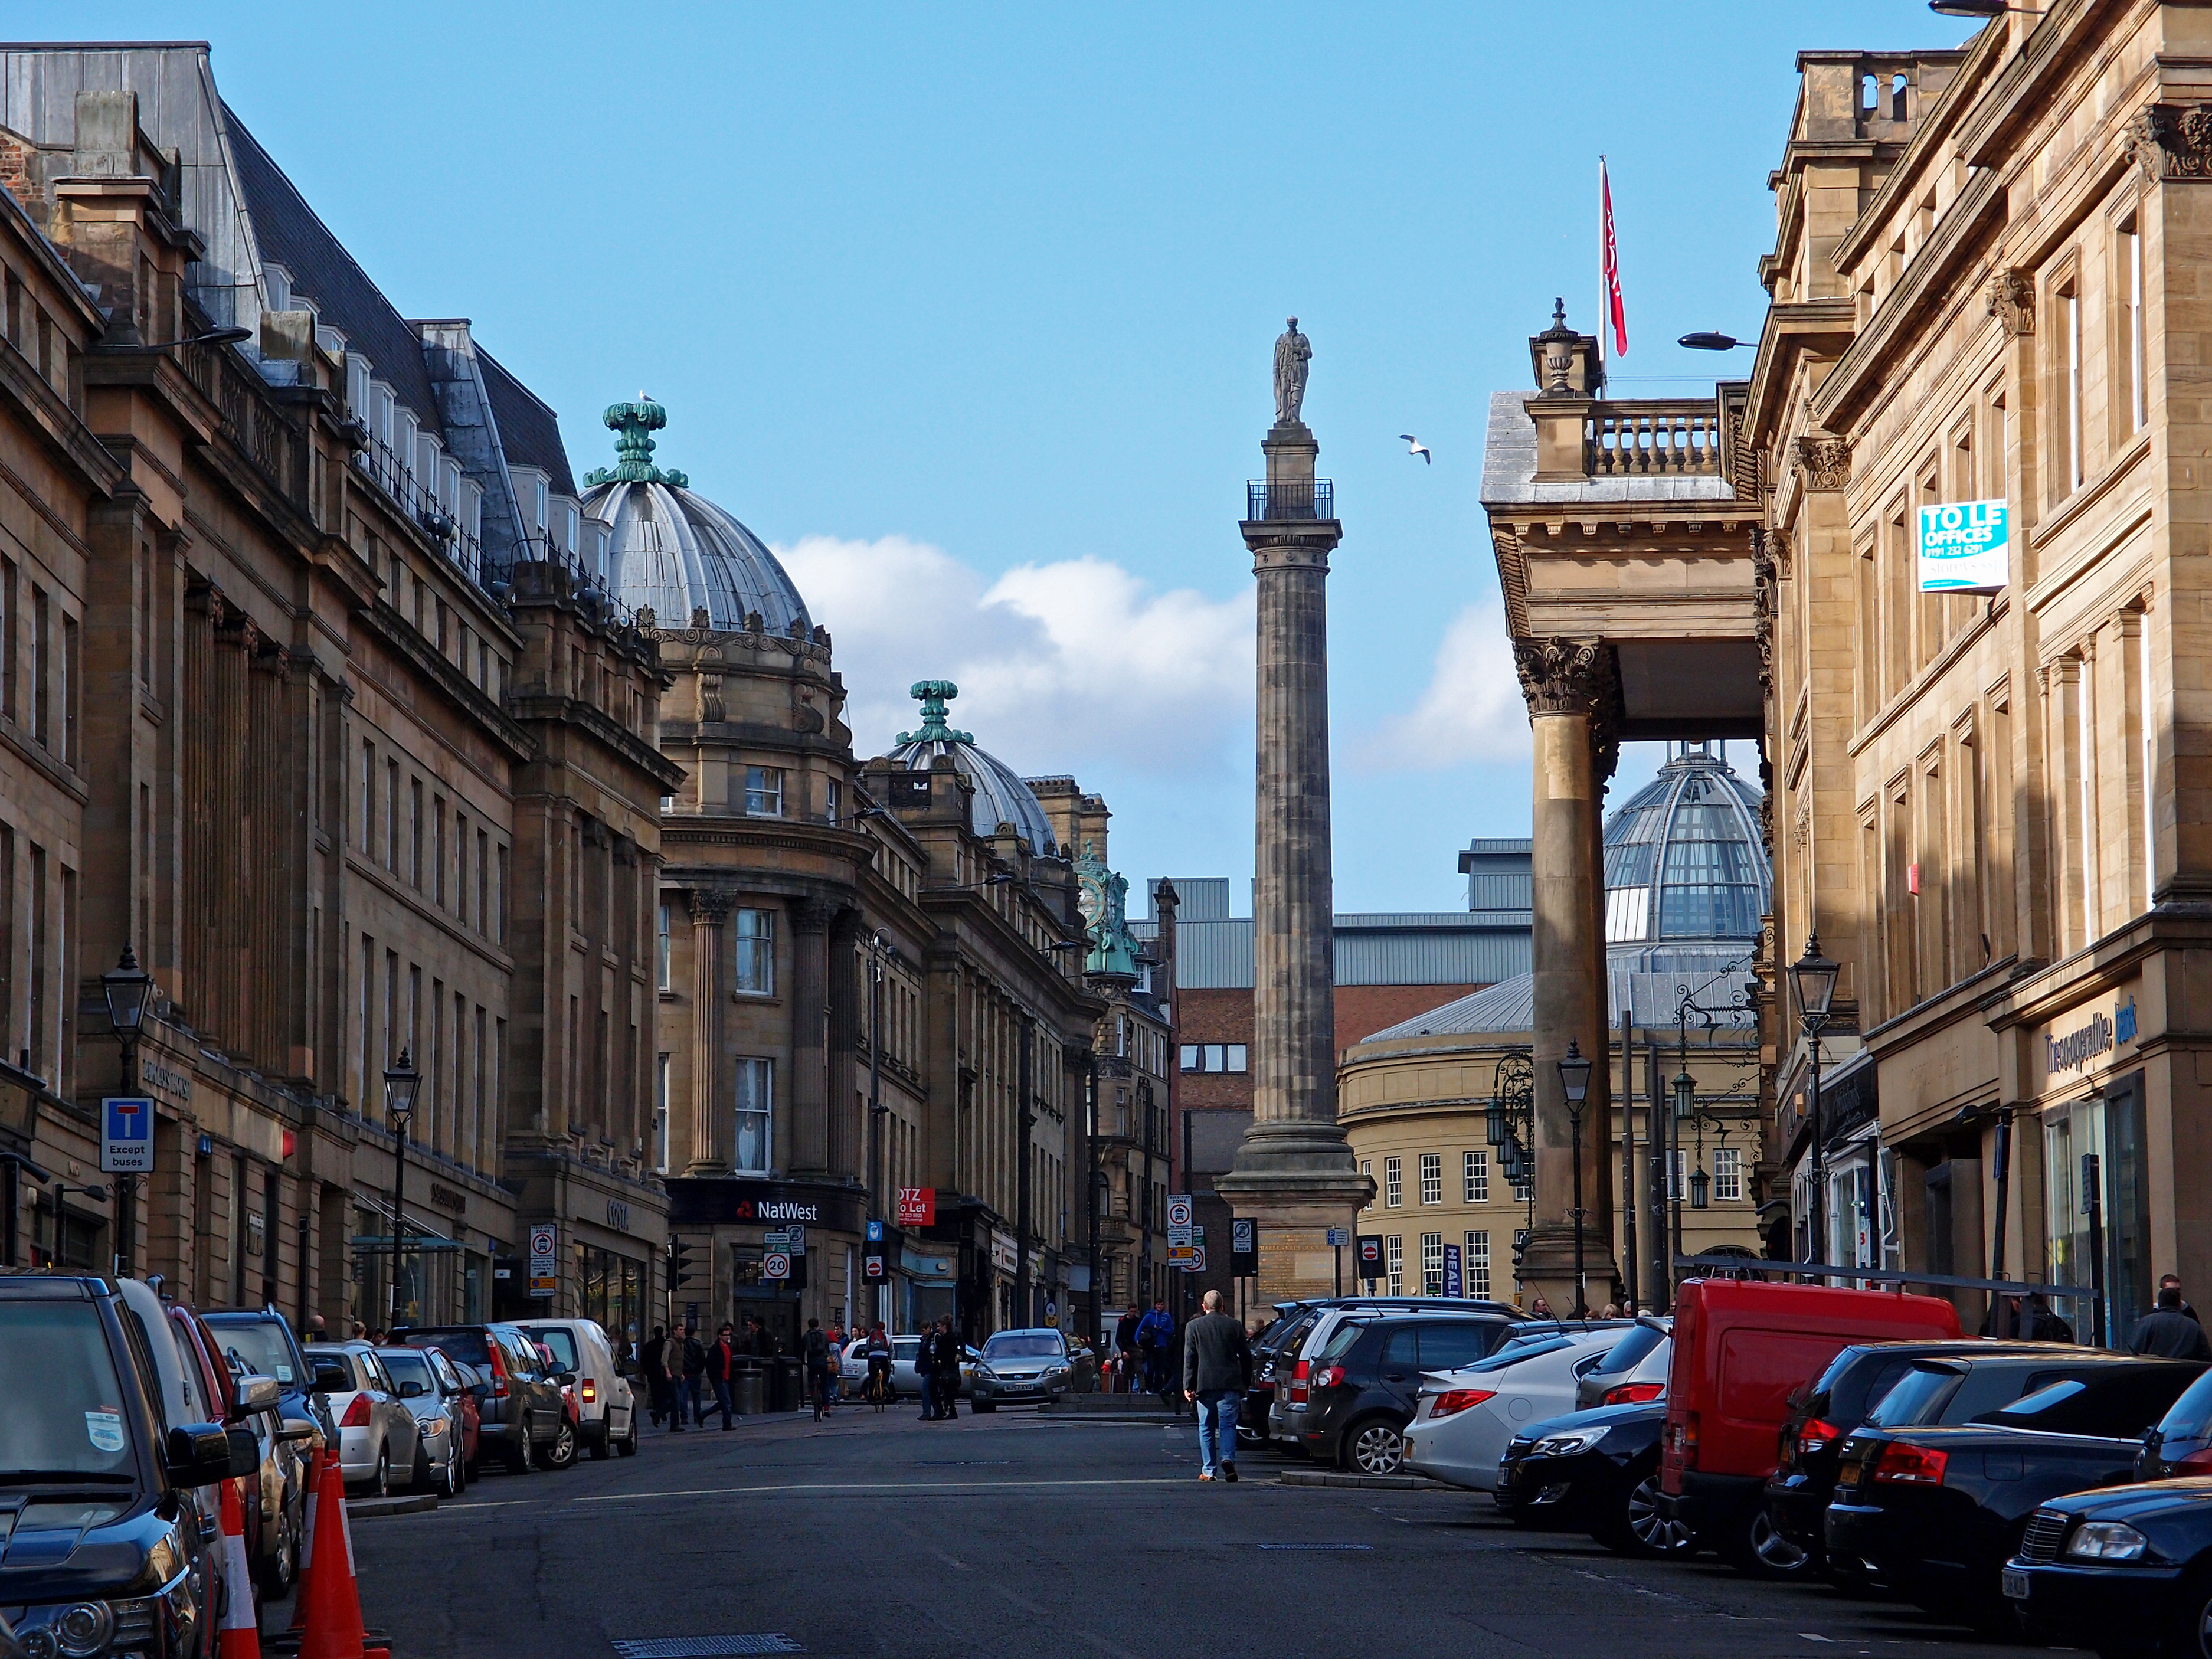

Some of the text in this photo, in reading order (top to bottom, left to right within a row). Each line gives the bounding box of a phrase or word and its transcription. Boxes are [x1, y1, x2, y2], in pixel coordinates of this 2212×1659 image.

[1923, 507, 1963, 531] TO
[1925, 526, 1993, 547] OFFICES
[2115, 994, 2138, 1045] bank
[110, 1146, 145, 1154] Except
[113, 1157, 143, 1166] buses
[758, 1201, 817, 1220] NatWest
[899, 1202, 926, 1213] o Let
[769, 1261, 786, 1271] 20
